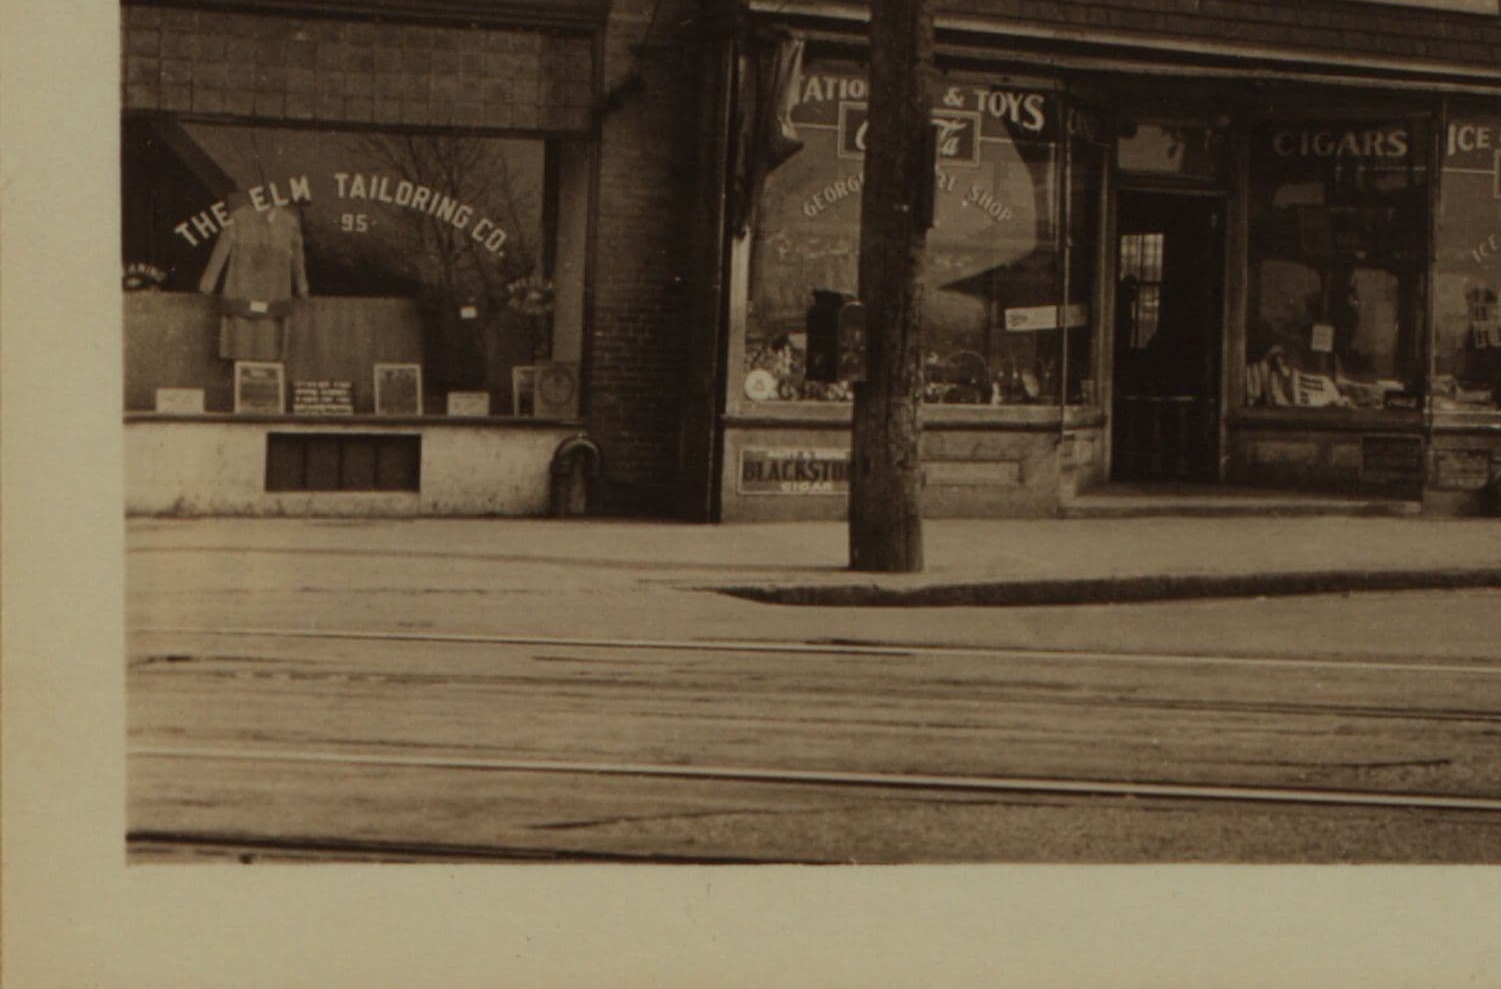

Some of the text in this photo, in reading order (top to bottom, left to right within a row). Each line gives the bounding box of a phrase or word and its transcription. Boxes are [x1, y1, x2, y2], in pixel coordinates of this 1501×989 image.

[943, 86, 965, 108] &
[973, 88, 1046, 132] TOYS
[1273, 129, 1409, 157] CIGARS
[1447, 123, 1491, 157] ICE
[174, 172, 508, 258] THE ELM TAILORING CO.
[968, 184, 1015, 222] SHOP
[1472, 233, 1500, 265] ICE
